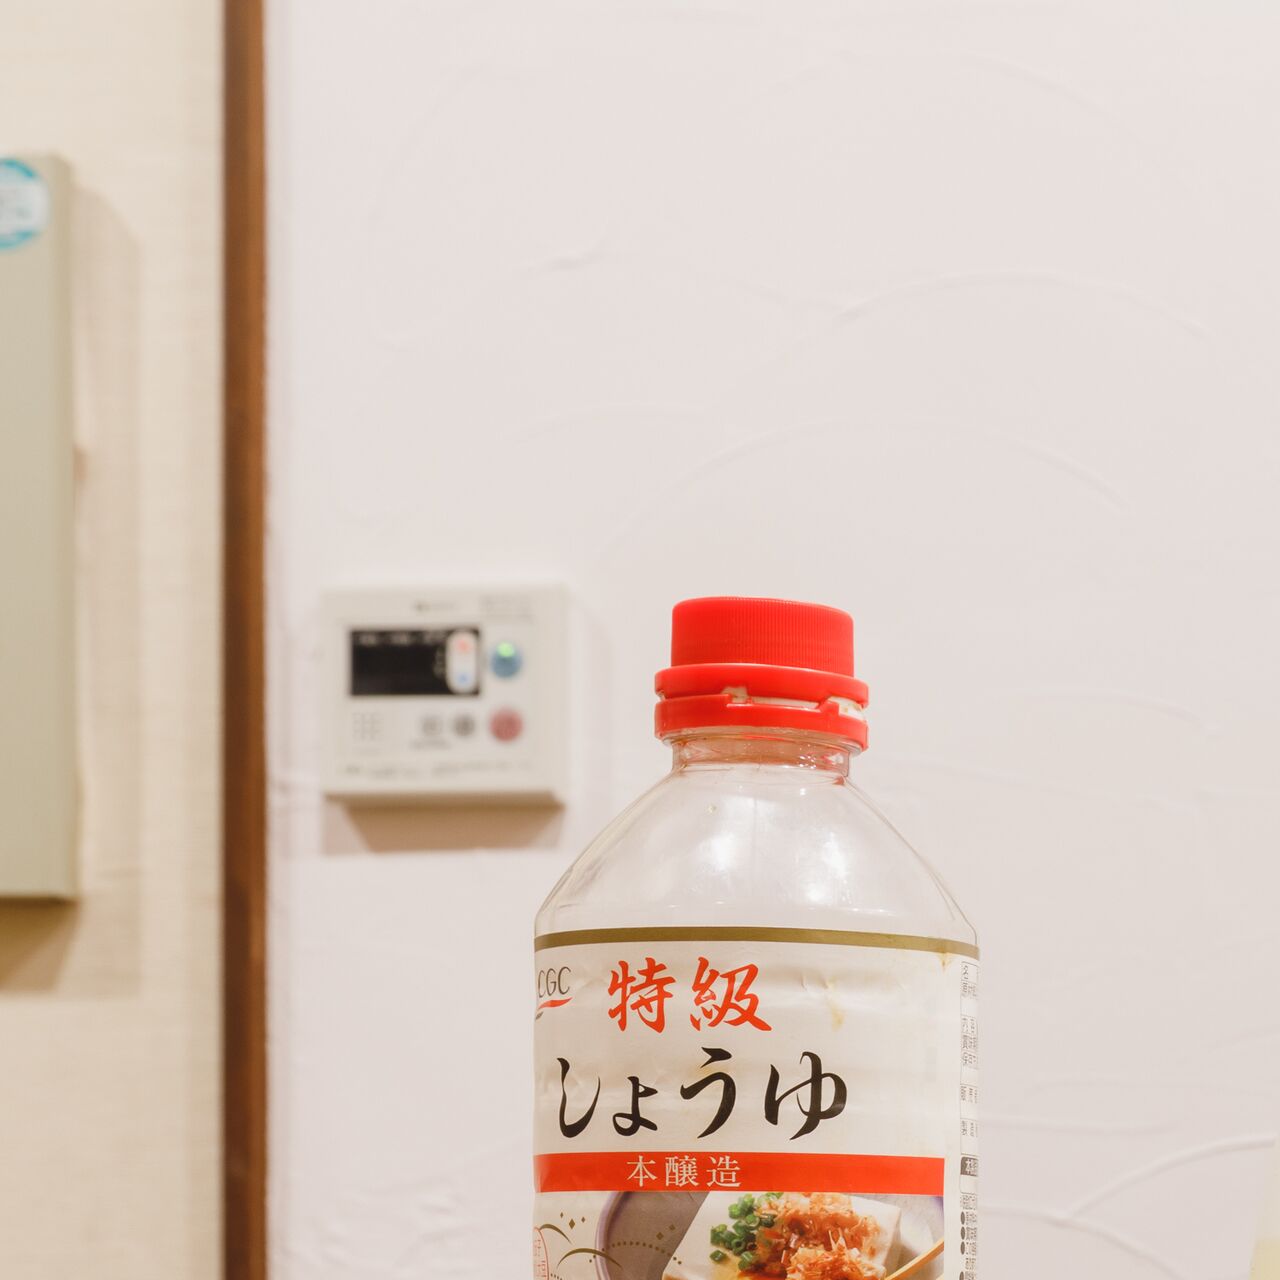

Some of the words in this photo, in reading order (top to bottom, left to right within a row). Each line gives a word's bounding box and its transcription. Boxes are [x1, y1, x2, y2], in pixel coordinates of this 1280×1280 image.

[606, 956, 772, 1033] 特級
[556, 1046, 848, 1140] しょうゆ
[626, 1155, 741, 1188] 本醸造
